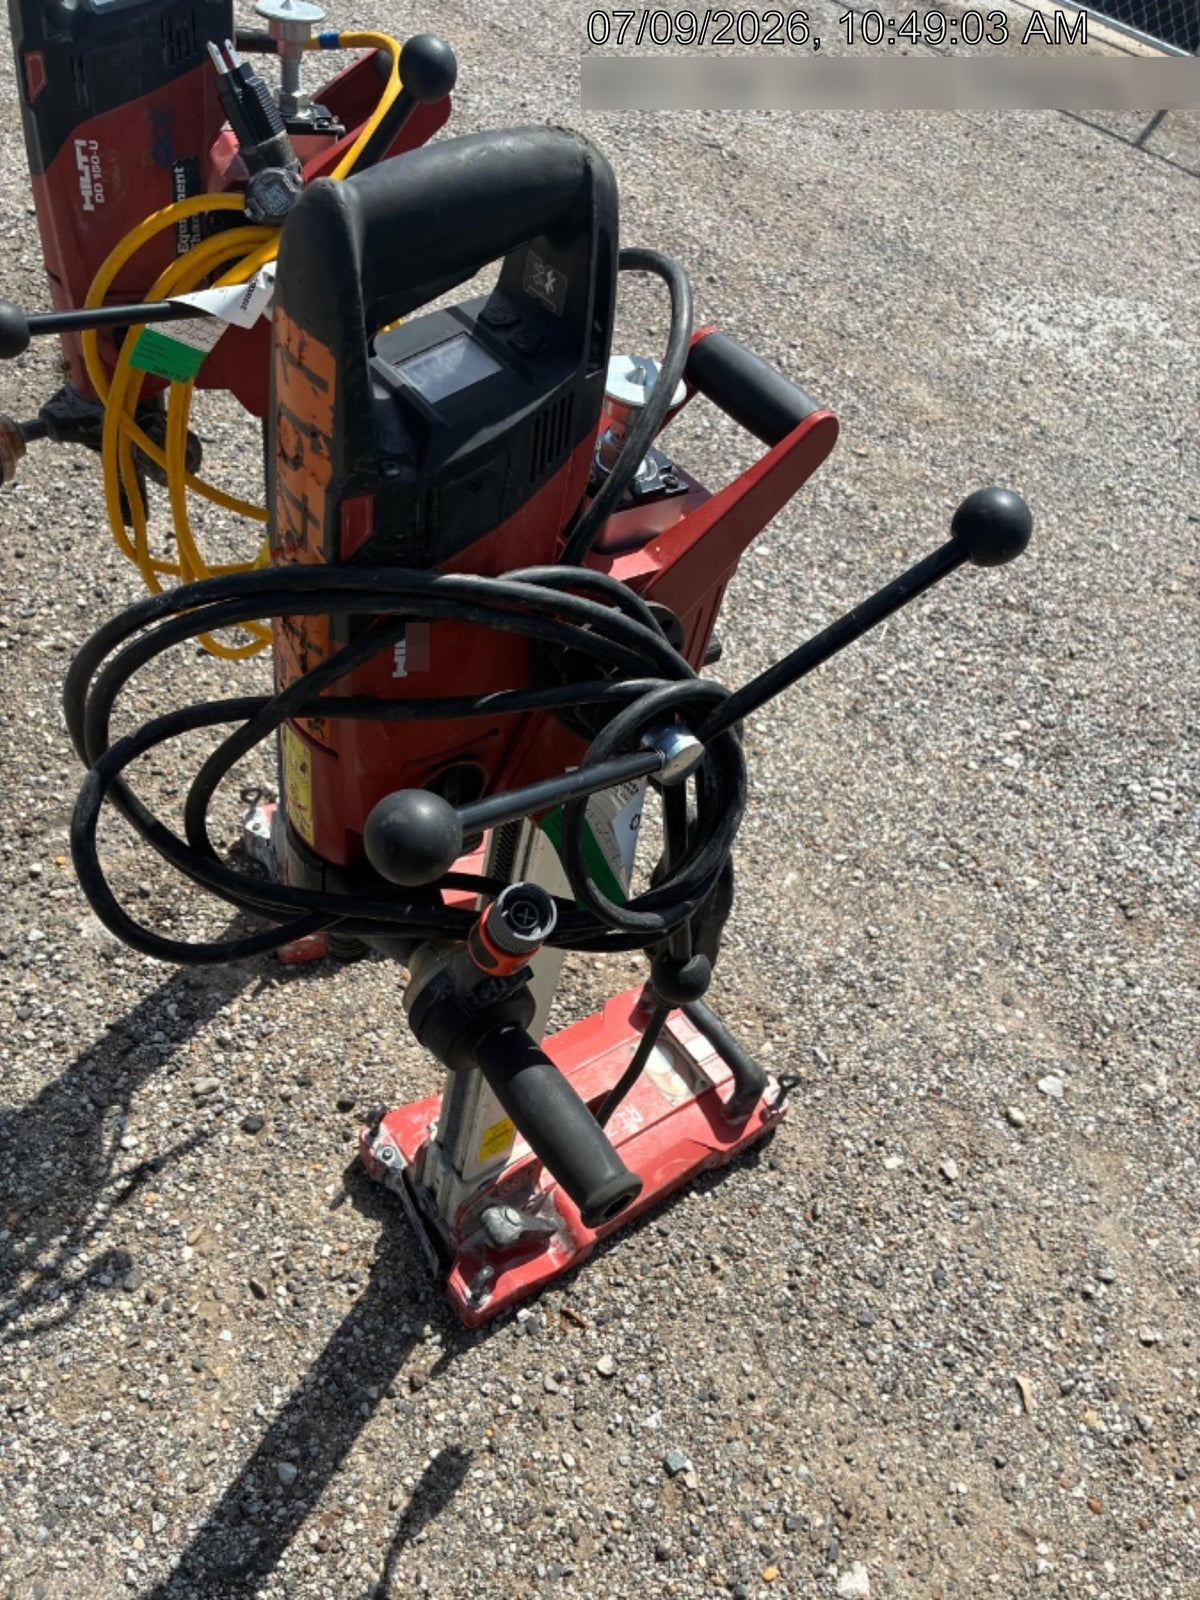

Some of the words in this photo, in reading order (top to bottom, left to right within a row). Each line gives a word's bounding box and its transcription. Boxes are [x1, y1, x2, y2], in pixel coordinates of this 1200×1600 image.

[74, 139, 95, 211] HILTI
[94, 182, 105, 203] DD
[174, 165, 191, 254] Equient
